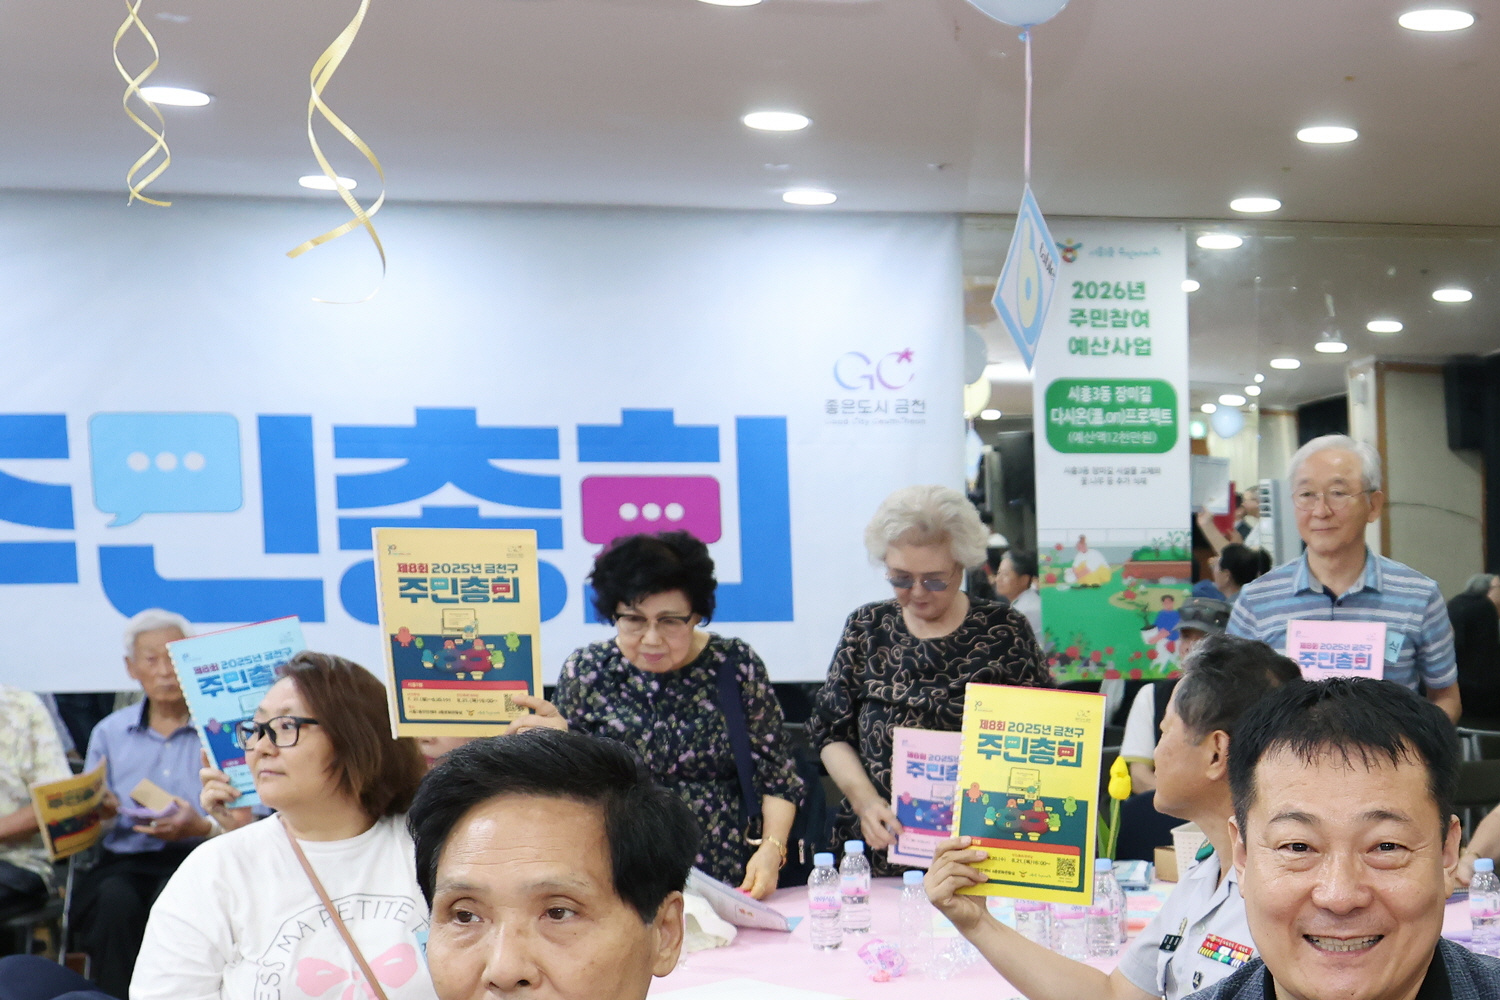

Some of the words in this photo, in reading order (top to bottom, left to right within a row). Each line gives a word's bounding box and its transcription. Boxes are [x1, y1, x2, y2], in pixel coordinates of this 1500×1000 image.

[1071, 281, 1146, 301] 2026년
[1068, 308, 1151, 328] 주민참여
[1068, 336, 1152, 357] 예산사업
[1114, 386, 1153, 404] 장미길
[824, 398, 888, 415] 좋은도시
[894, 398, 926, 414] 금천
[397, 562, 429, 574] 제8회
[431, 563, 482, 574] 2025년
[484, 563, 519, 575] 금천구
[398, 575, 520, 604] 주민총회
[1320, 643, 1350, 651] 2025년
[220, 653, 263, 671] 2025년
[1298, 651, 1372, 671] 주민총회
[979, 719, 1006, 732] 제8회
[1008, 721, 1052, 736] 2025년
[1053, 724, 1085, 739] 금천구
[976, 733, 1084, 768] 주민총회
[276, 919, 317, 954] MA
[319, 898, 416, 929] PETITE
